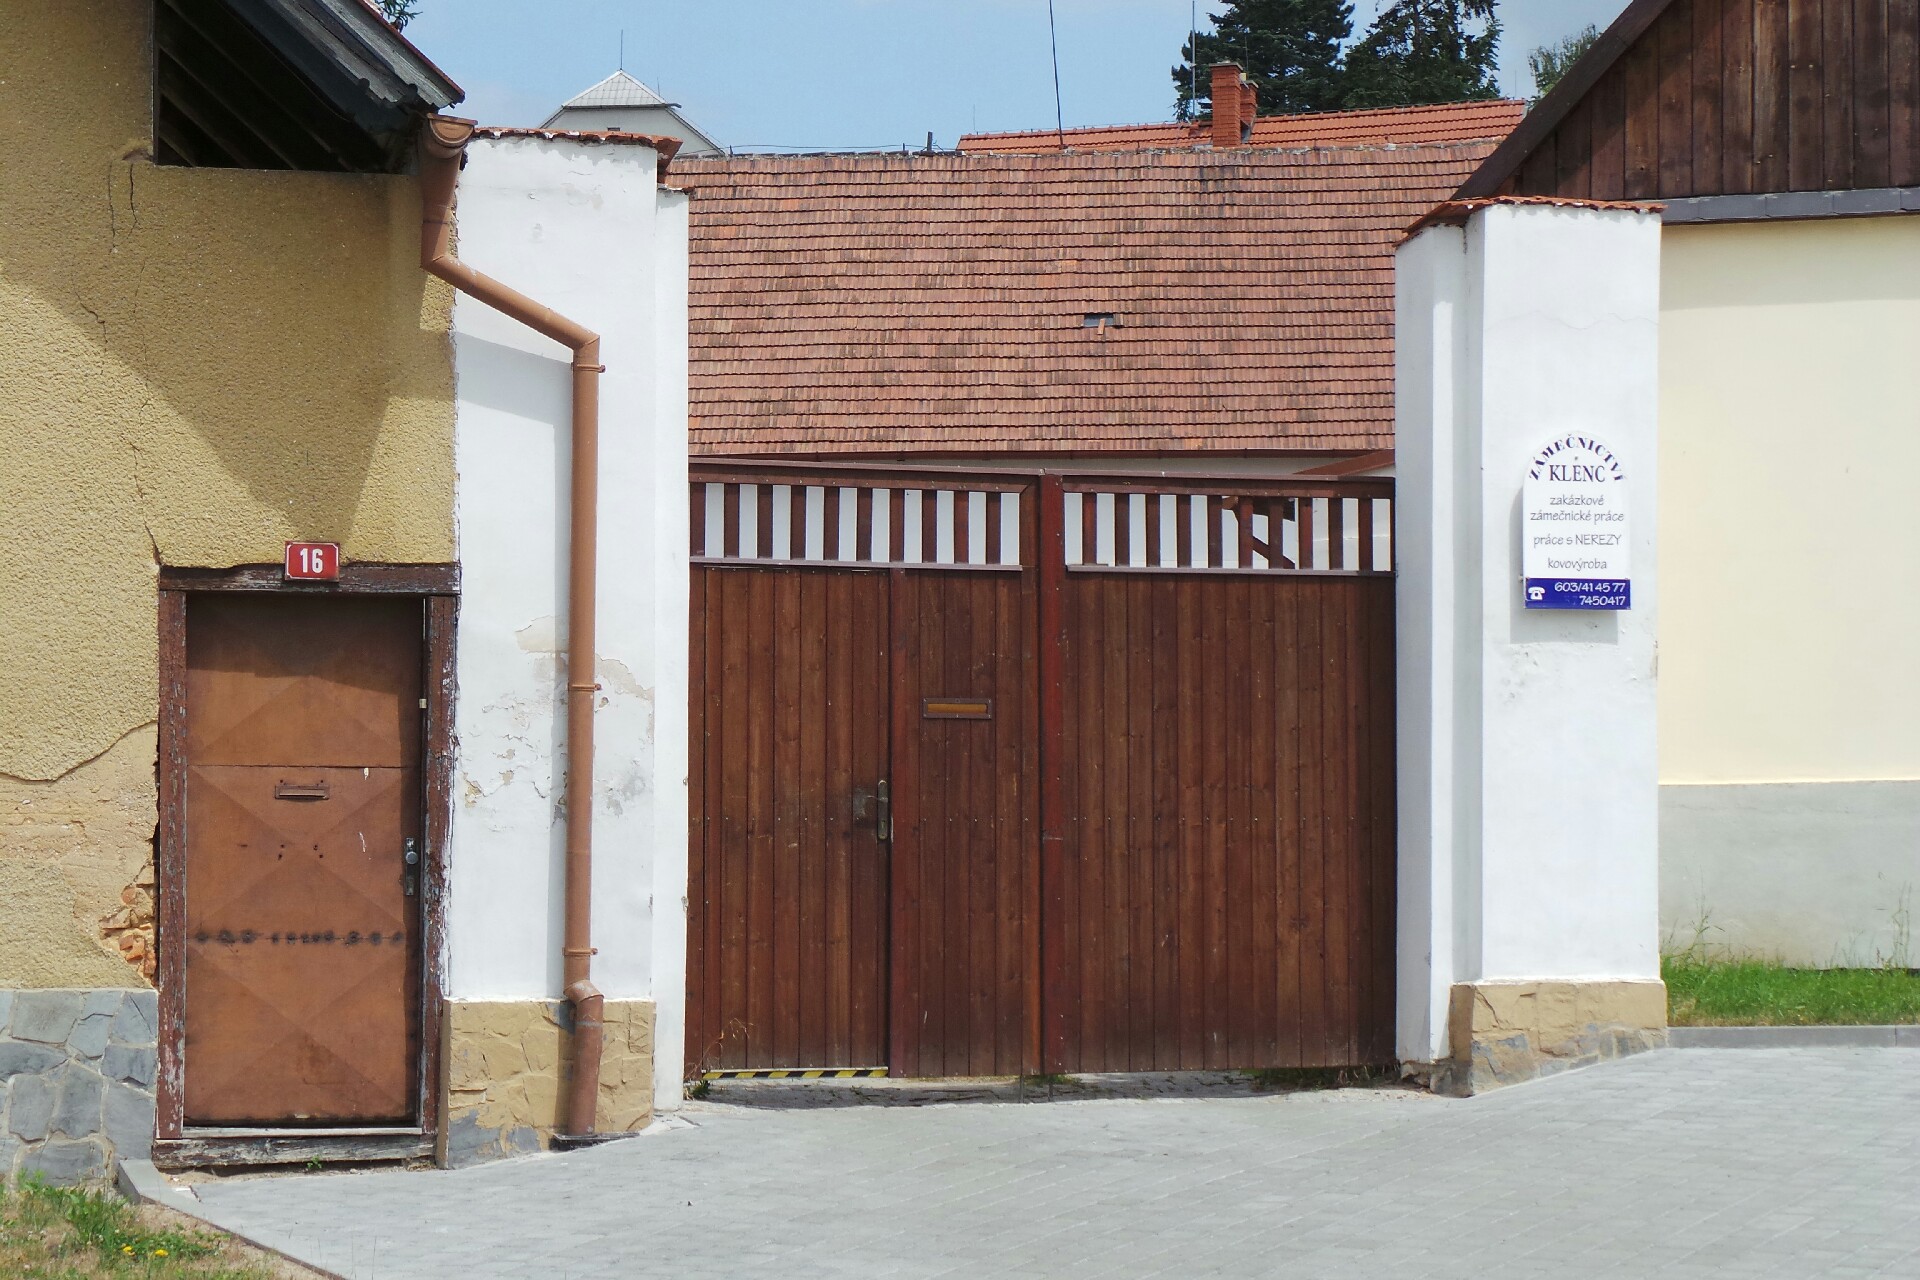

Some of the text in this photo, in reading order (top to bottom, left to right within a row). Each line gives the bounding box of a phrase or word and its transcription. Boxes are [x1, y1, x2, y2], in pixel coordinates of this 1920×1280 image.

[1549, 465, 1606, 482] KLENC
[1549, 494, 1605, 506] zakázkové
[1530, 510, 1625, 525] zámečnické práce
[1533, 533, 1622, 548] práce s NEREZY
[300, 548, 323, 573] 16
[1547, 557, 1607, 571] kovovýroba
[1554, 581, 1626, 593] 603/41 45 77
[1579, 595, 1626, 606] 7450417
